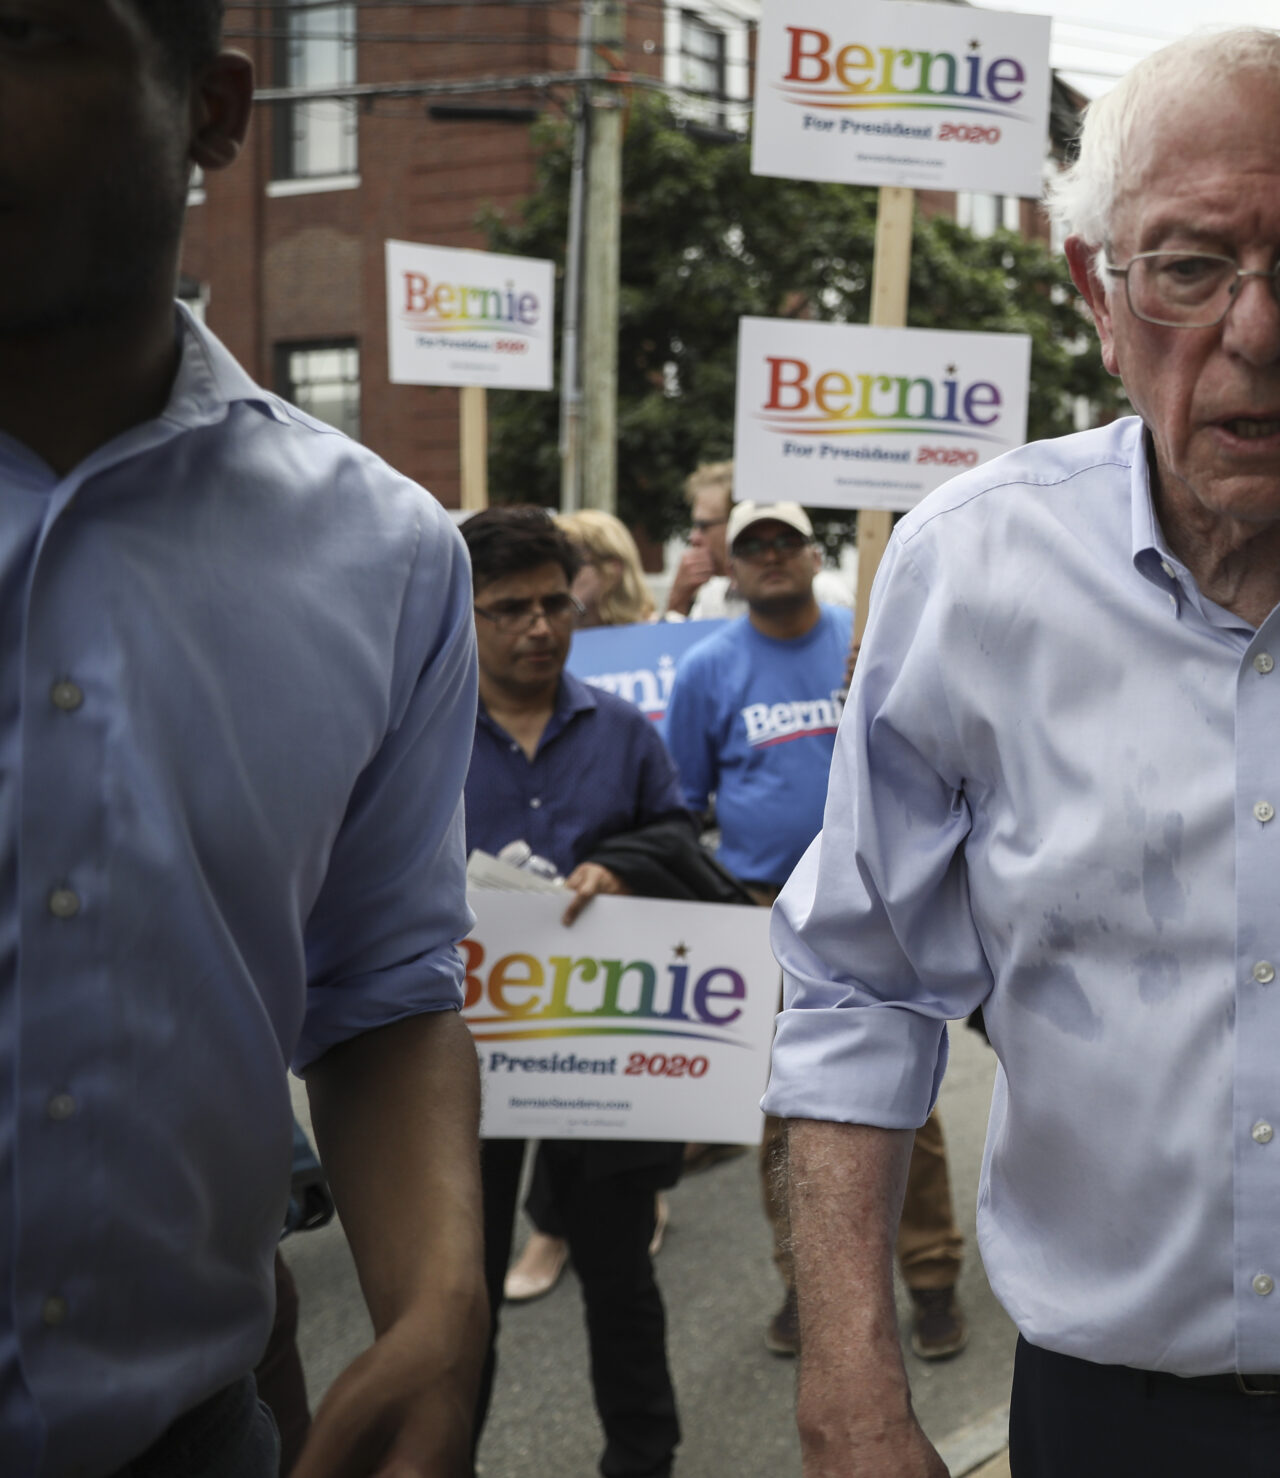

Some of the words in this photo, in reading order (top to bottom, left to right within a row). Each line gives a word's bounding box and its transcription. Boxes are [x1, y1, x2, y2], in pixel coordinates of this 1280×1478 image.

[782, 26, 1027, 103] Bernie
[803, 114, 835, 131] For
[840, 117, 933, 140] President
[936, 121, 1002, 145] 2020
[403, 270, 541, 325] Bernie
[762, 356, 1004, 427] Bernie
[783, 440, 814, 458] For
[819, 442, 911, 464] President
[915, 445, 979, 467] 2020
[489, 1052, 618, 1075] President
[624, 1052, 710, 1079] 2020
